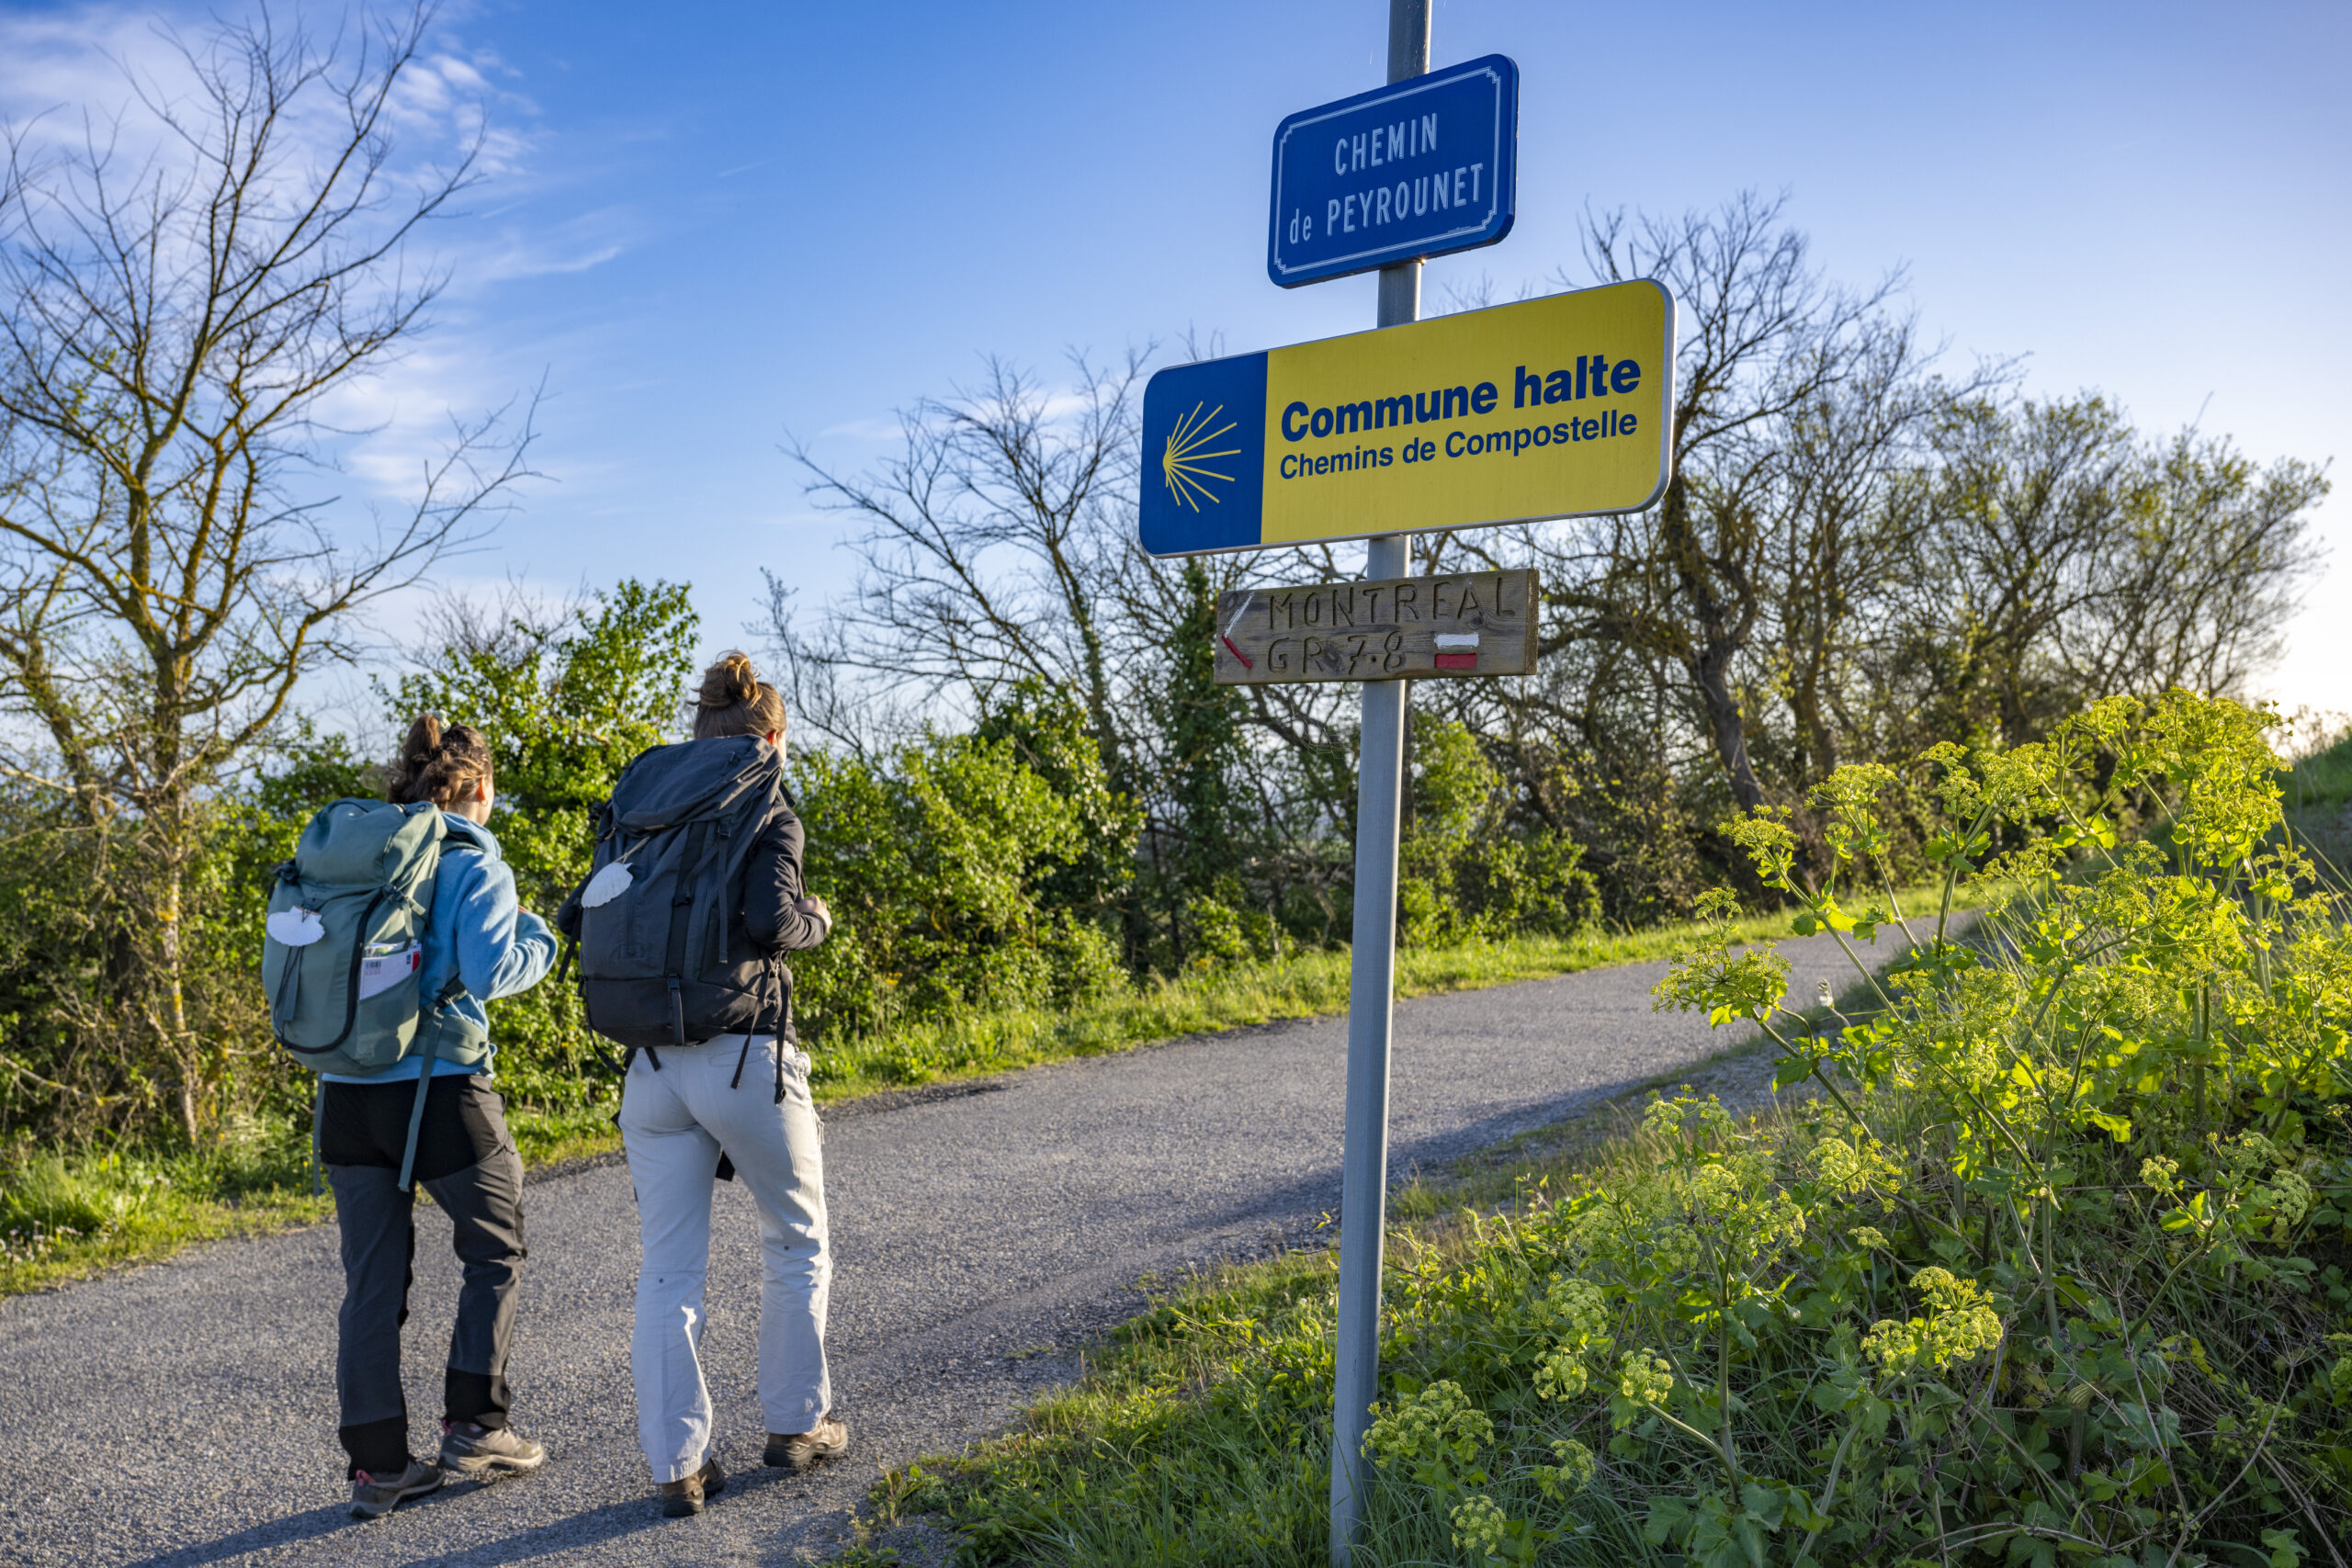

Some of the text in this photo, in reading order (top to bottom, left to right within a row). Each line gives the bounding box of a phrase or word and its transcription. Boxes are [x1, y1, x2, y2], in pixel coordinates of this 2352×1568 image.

[1335, 112, 1438, 176] CHEMIN
[1289, 162, 1484, 245] de PEYROUNET
[1280, 353, 1642, 443] Commune halte
[1280, 409, 1639, 480] Chemins de Compostelle
[1268, 576, 1517, 631] MONTREAL
[1266, 635, 1325, 674] GR
